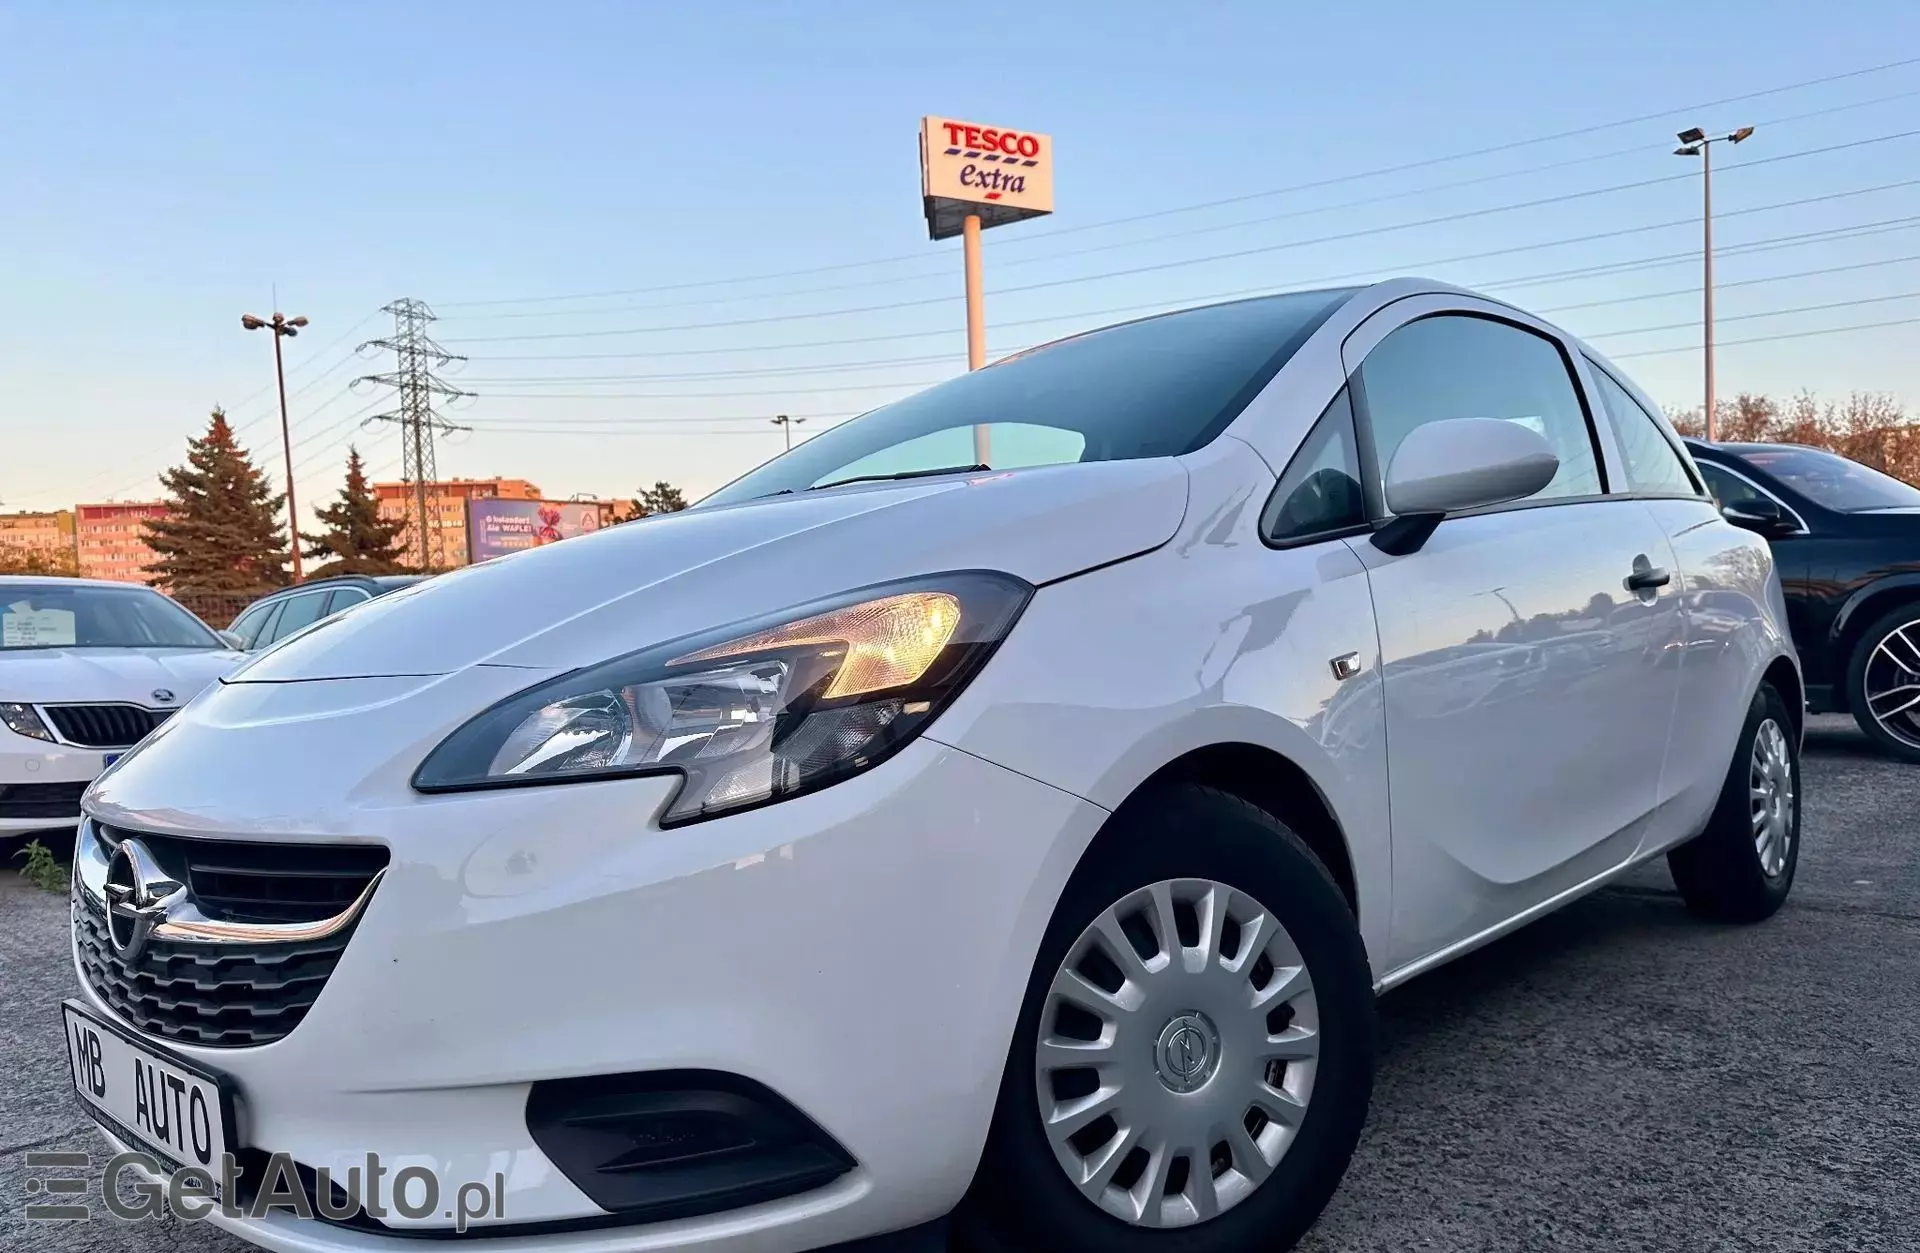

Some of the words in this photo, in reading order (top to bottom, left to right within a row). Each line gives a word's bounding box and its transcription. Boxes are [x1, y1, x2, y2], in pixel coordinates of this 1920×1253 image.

[943, 122, 1039, 157] TESCO
[960, 164, 1025, 193] extra
[502, 524, 532, 533] WAFLE!
[74, 1021, 105, 1098] MB
[135, 1056, 211, 1165] AUTO
